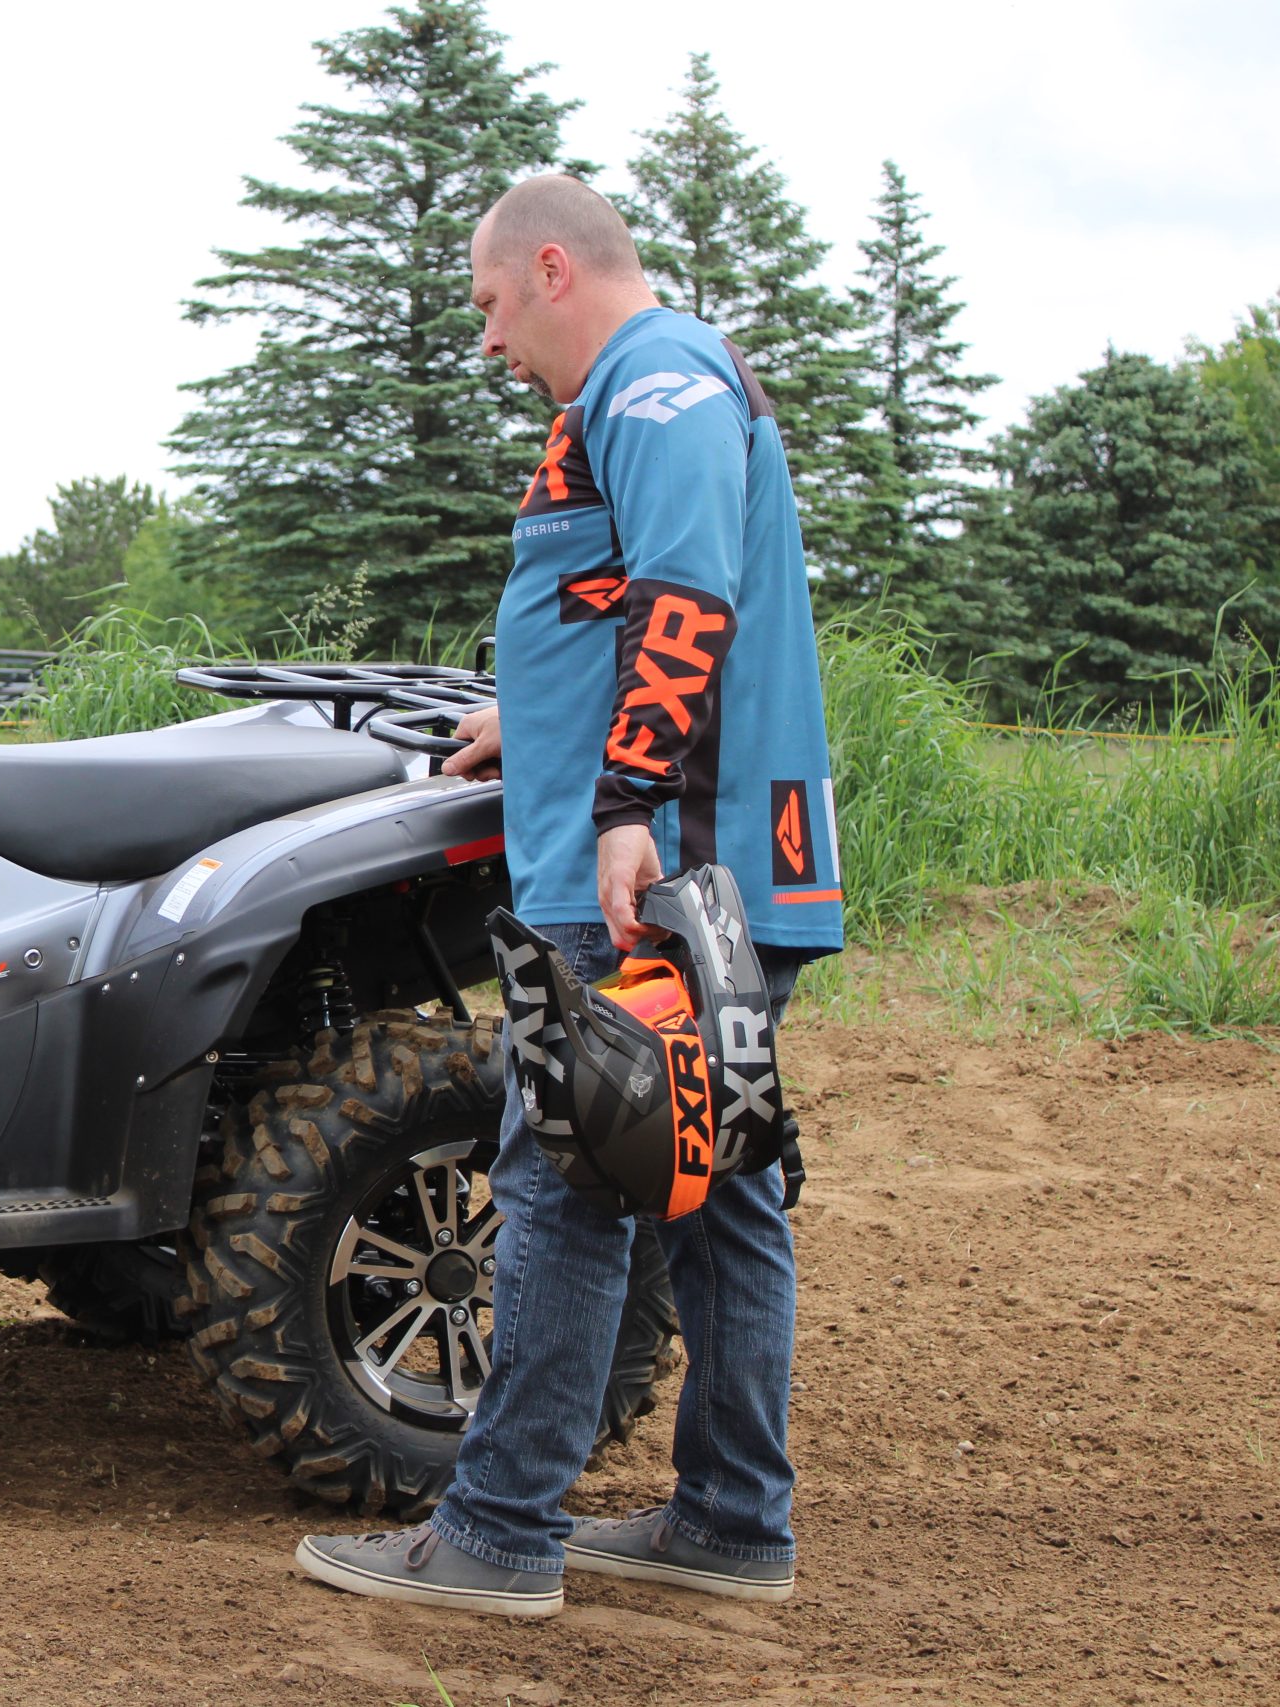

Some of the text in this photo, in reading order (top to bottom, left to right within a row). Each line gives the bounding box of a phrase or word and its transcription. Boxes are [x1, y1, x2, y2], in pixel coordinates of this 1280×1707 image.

[525, 520, 570, 537] SERIES
[607, 594, 726, 775] FXR
[557, 962, 580, 991] FXR
[670, 1038, 710, 1177] FXR
[712, 1006, 776, 1172] FXR
